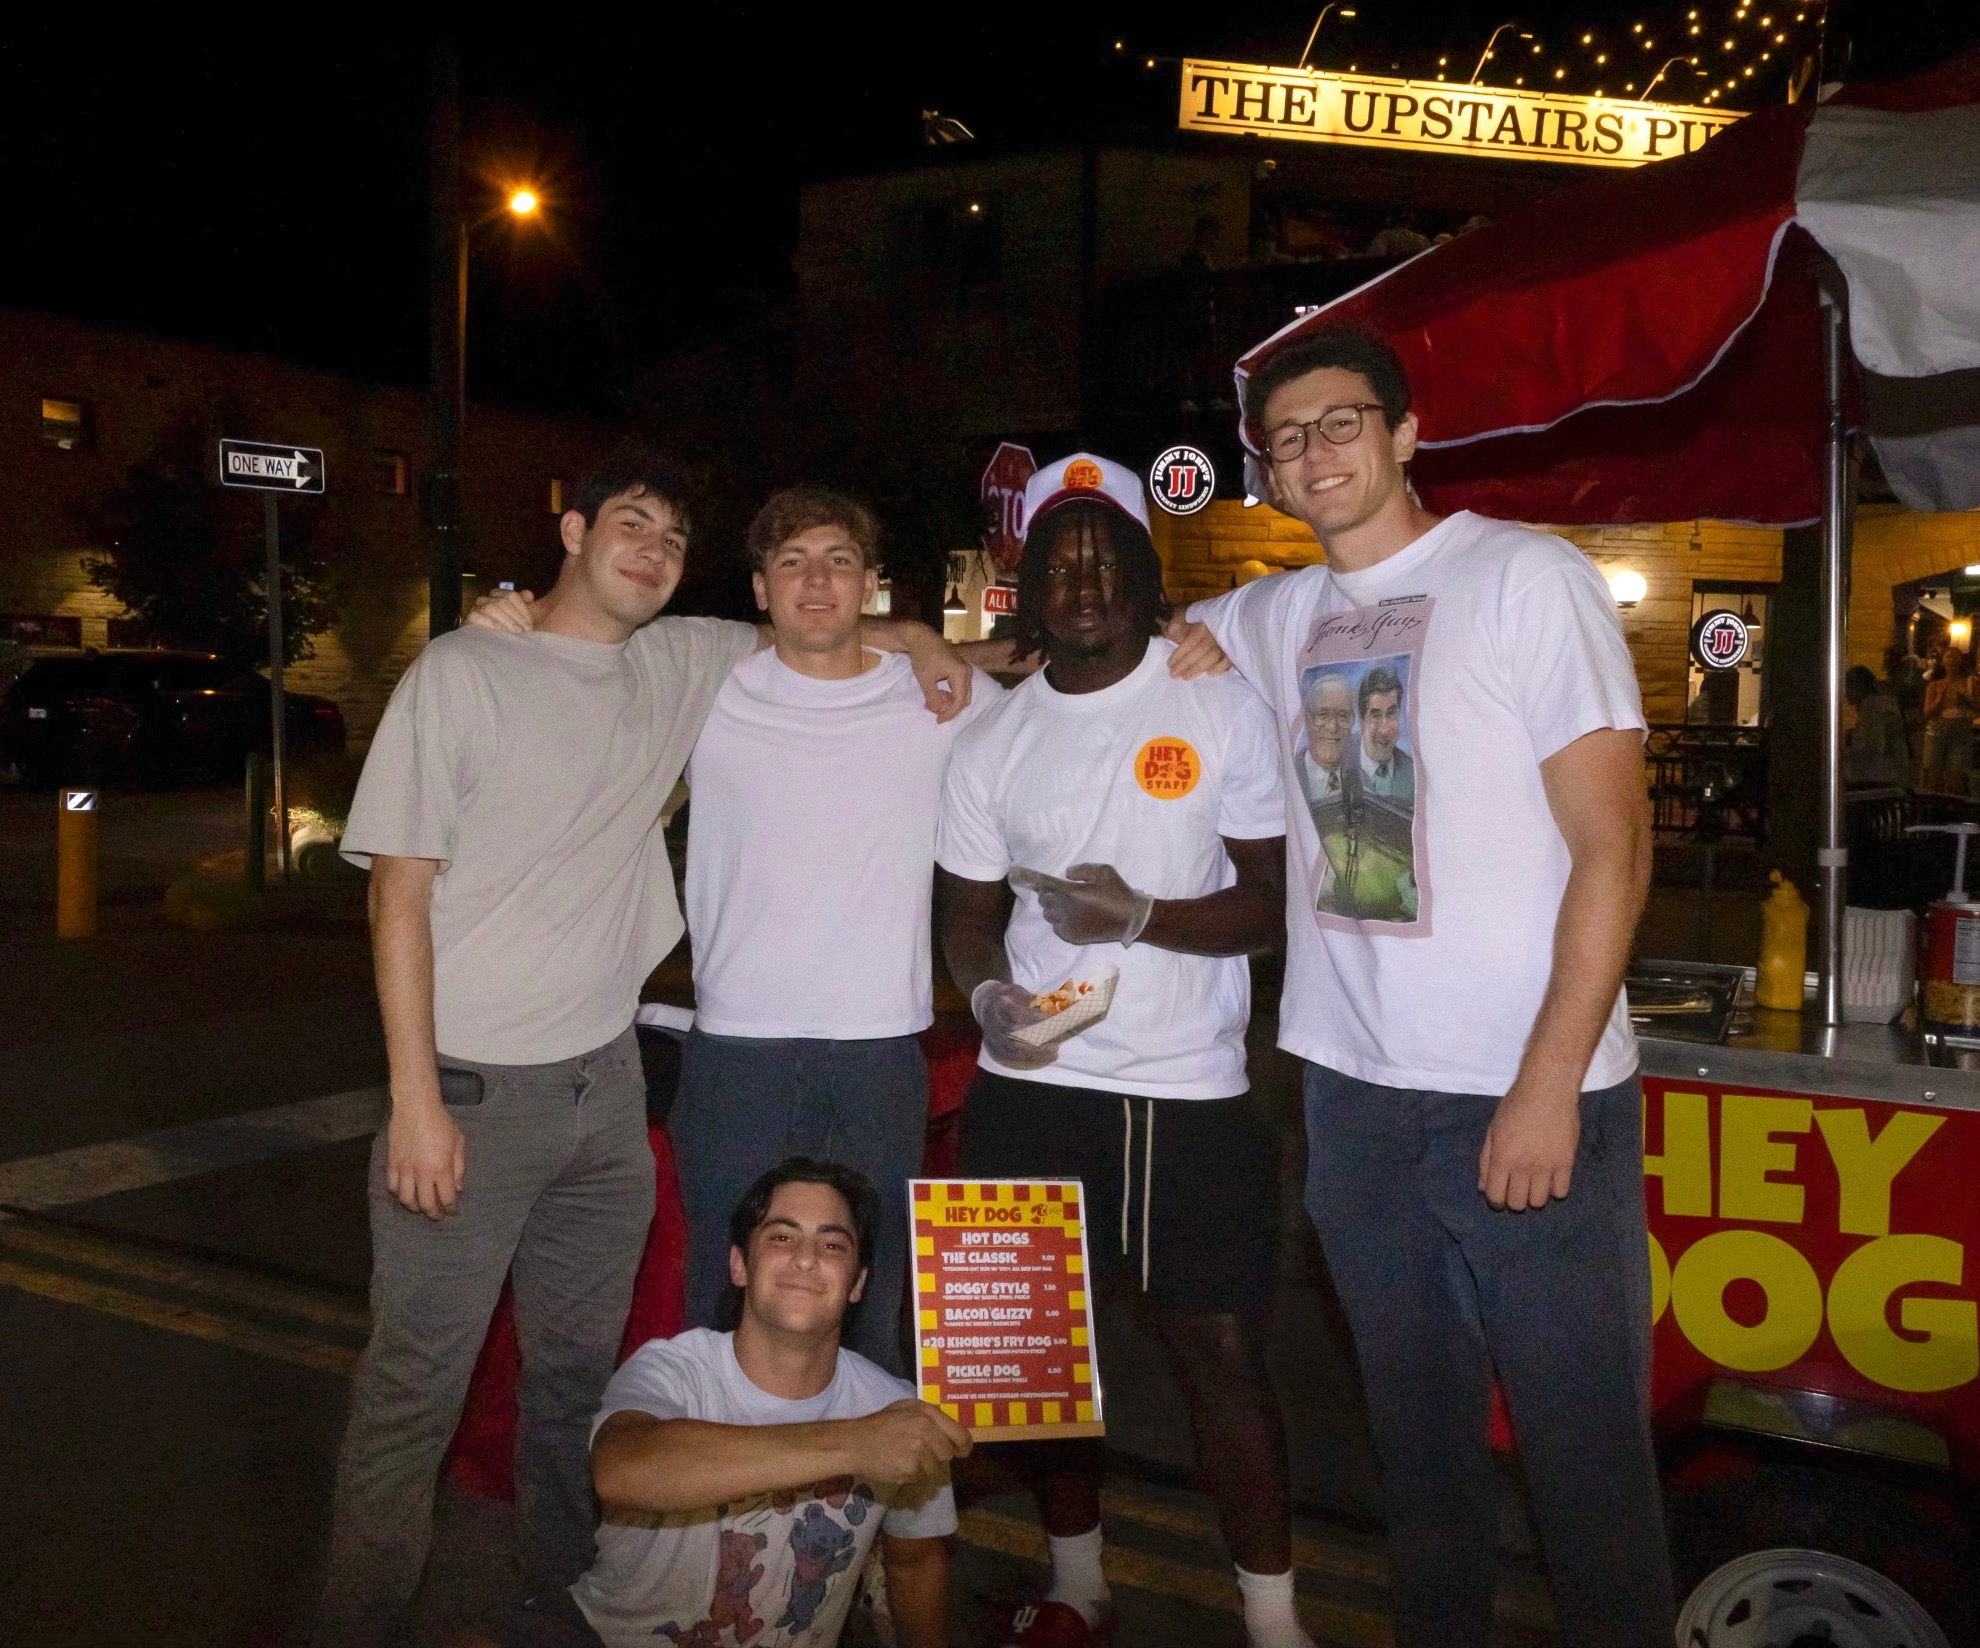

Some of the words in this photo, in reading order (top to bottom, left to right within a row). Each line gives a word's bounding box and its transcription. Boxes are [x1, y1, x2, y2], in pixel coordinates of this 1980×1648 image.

[1191, 75, 1317, 126] THE
[1342, 89, 1624, 156] UPSTAIRS
[1643, 117, 1731, 155] PU
[232, 455, 260, 473] ONE
[264, 458, 293, 476] WAY
[1070, 466, 1096, 477] HEY
[1154, 450, 1181, 481] JIMMY
[1183, 450, 1211, 482] JOHN'S
[1168, 465, 1198, 497] JJ
[989, 593, 1008, 608] ALL
[1712, 628, 1736, 654] JJ
[1149, 746, 1187, 762] HEY
[1146, 780, 1189, 790] STAFF
[945, 1206, 981, 1223] HEY
[984, 1206, 1022, 1223] DOG
[961, 1232, 990, 1245] HOT
[992, 1232, 1030, 1245] DOGS
[941, 1252, 966, 1264] THE
[967, 1252, 1017, 1264] CLASSIC
[945, 1282, 989, 1295] DOGGY
[990, 1307, 1033, 1320] GLIZZY
[1648, 1229, 1980, 1393] OG
[1003, 1336, 1025, 1348] FRY
[1027, 1335, 1052, 1347] DOG
[994, 1365, 1021, 1377] DOG
